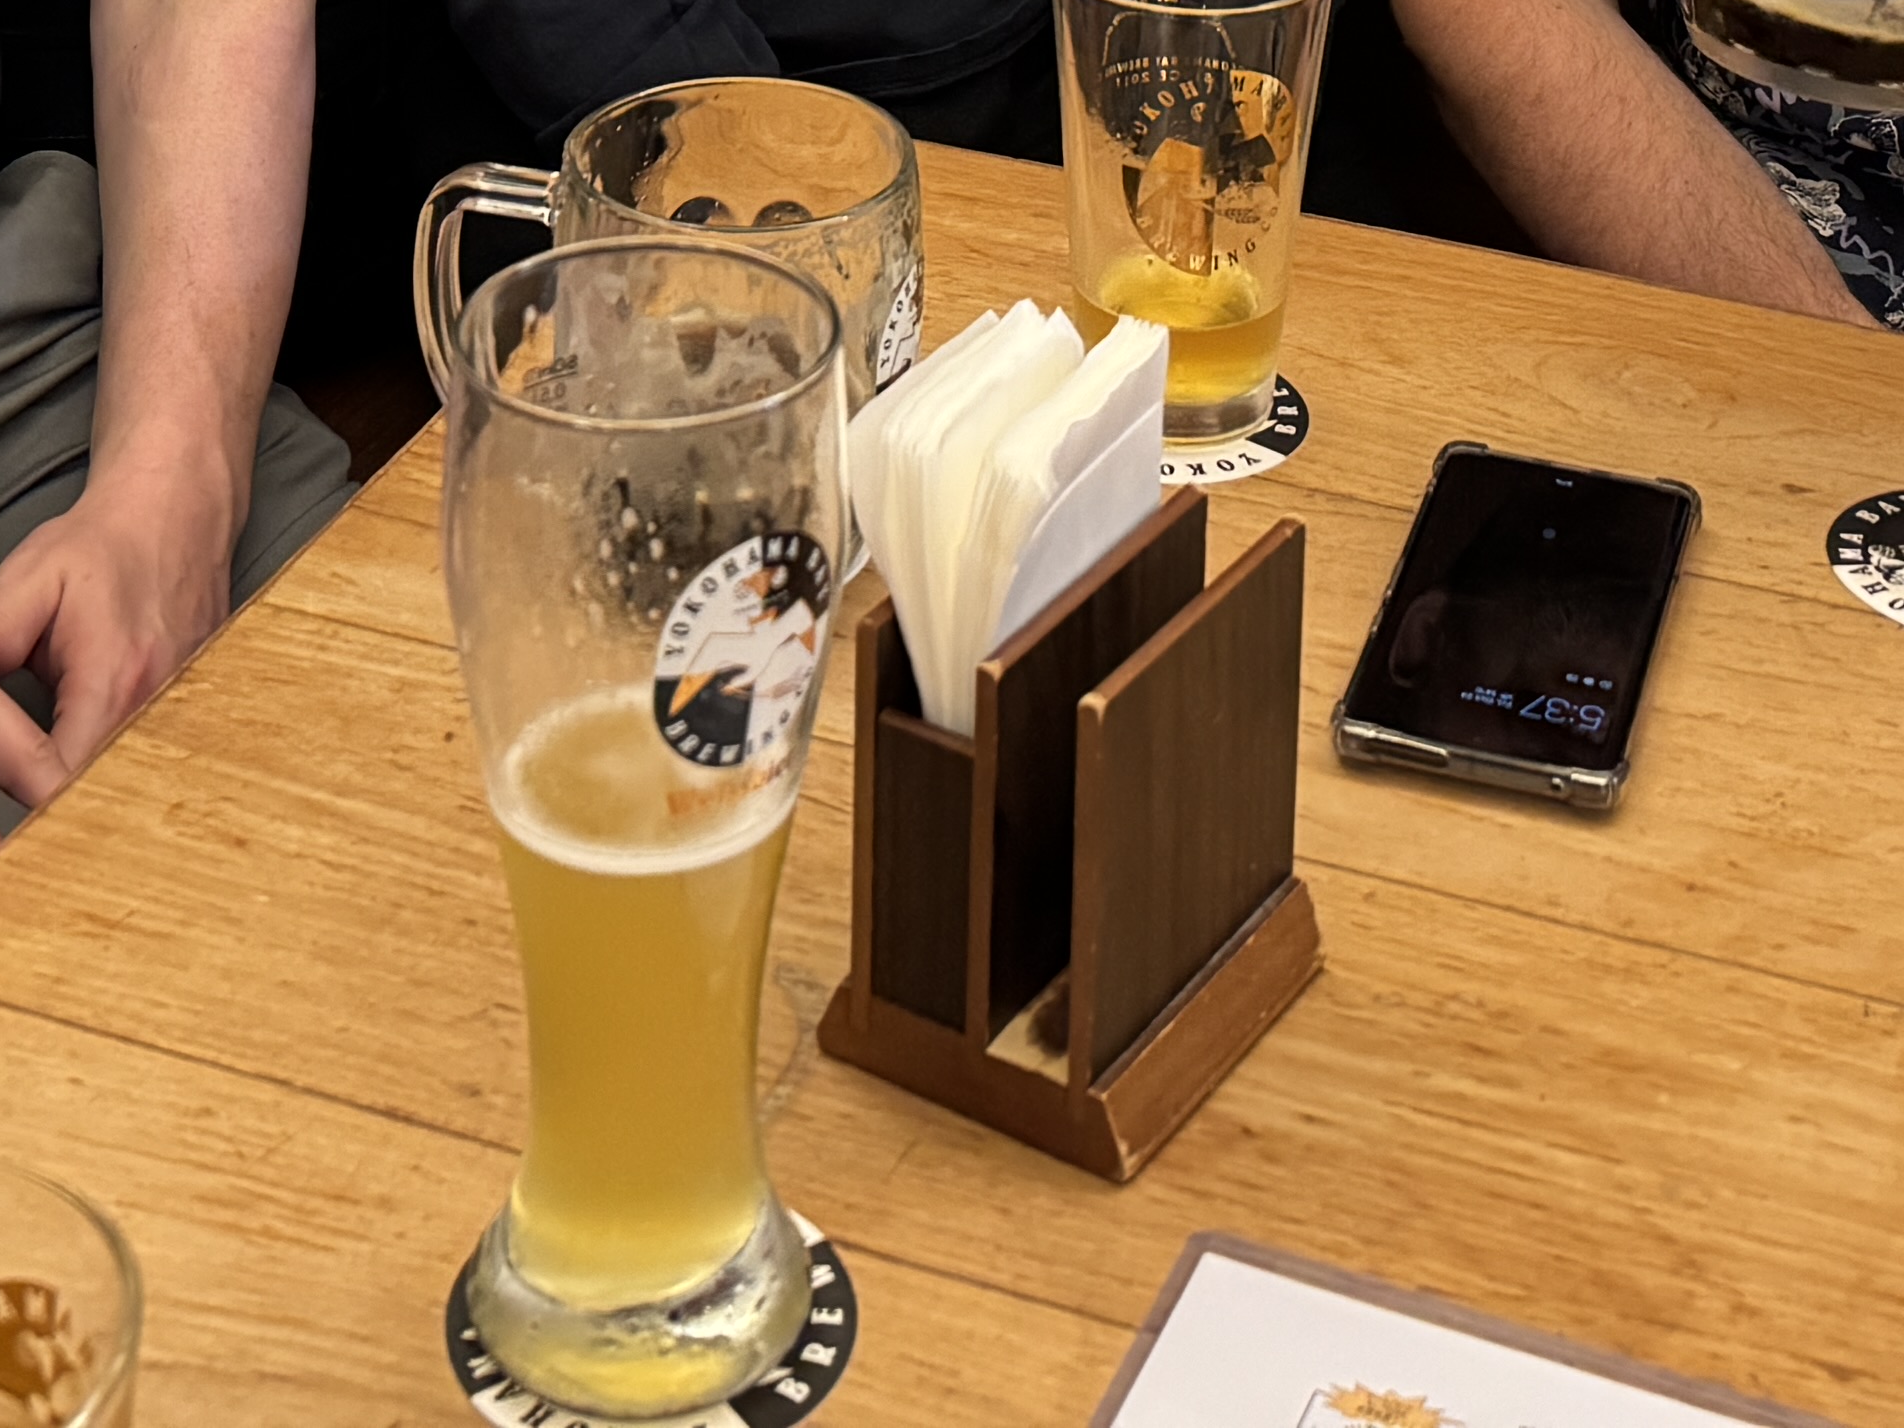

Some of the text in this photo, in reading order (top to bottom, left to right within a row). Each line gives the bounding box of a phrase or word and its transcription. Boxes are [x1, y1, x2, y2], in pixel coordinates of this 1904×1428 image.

[663, 535, 800, 659] YOKOHAMA
[1519, 694, 1607, 732] 5:37
[774, 1262, 845, 1404] BREW
